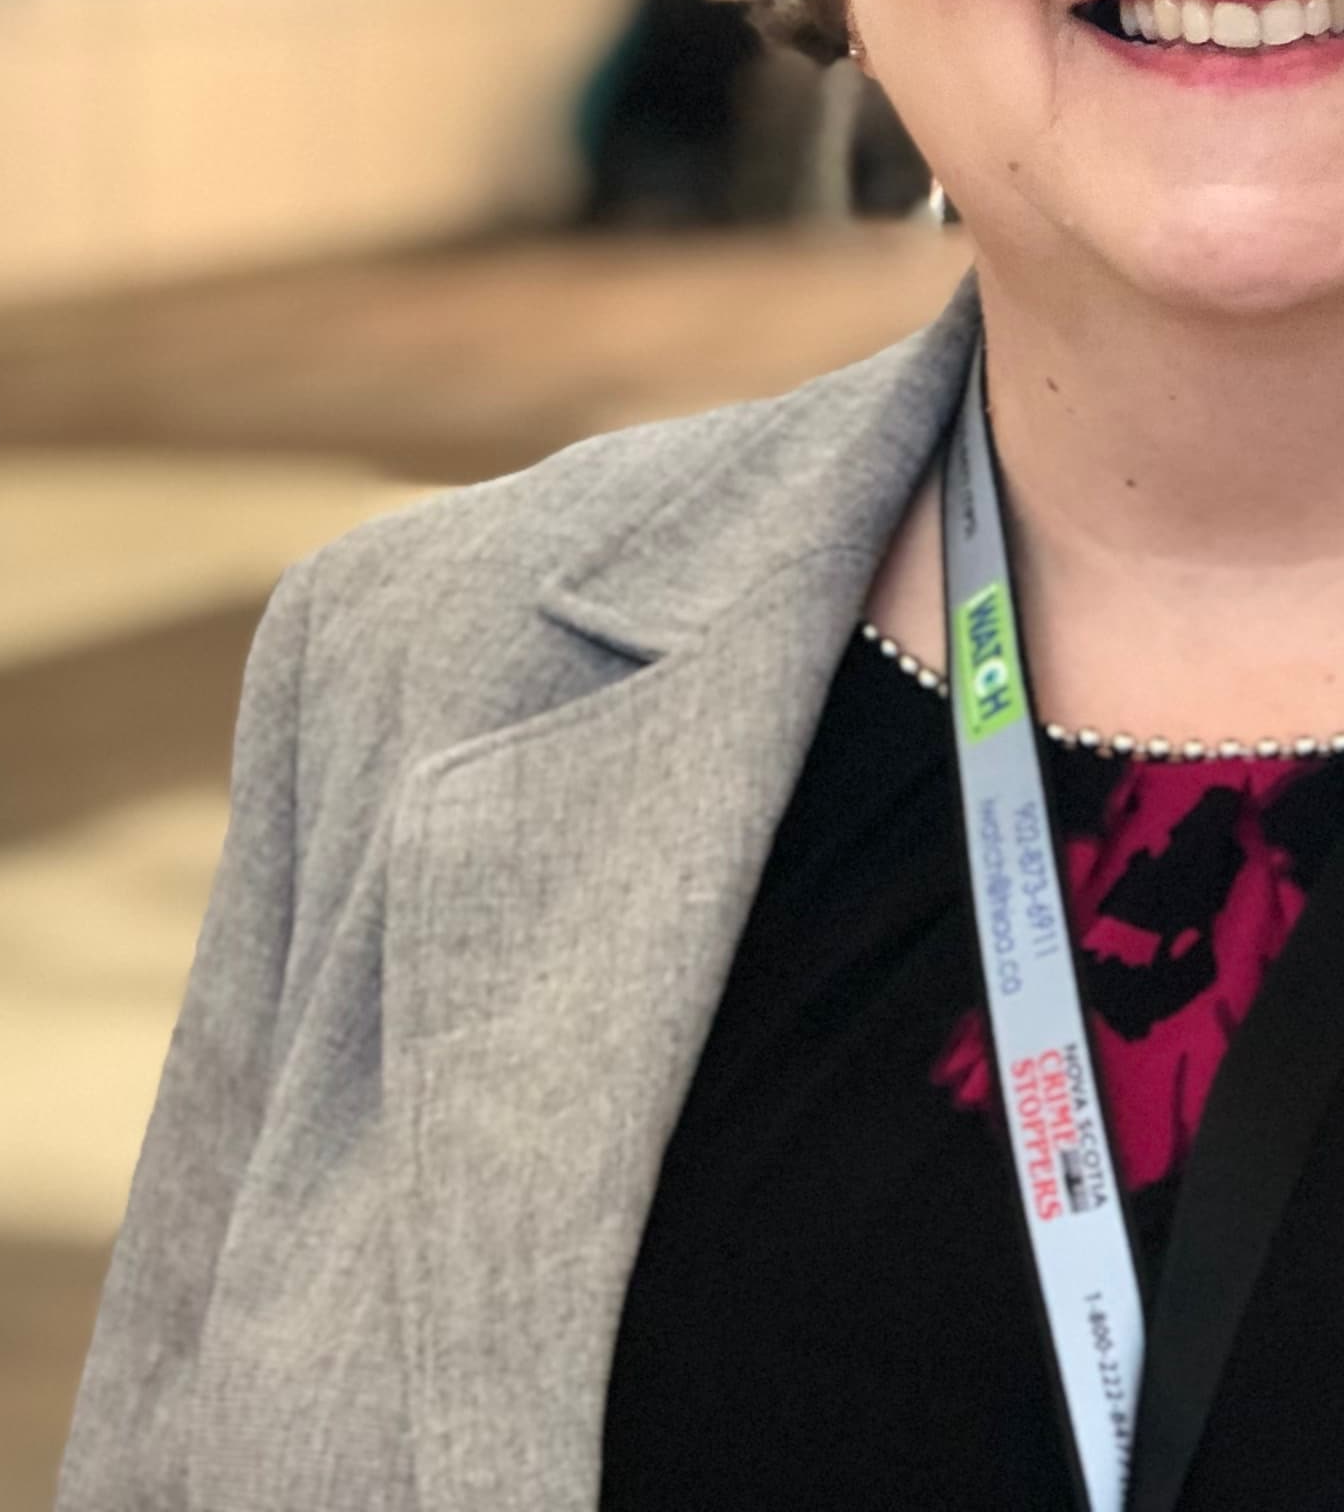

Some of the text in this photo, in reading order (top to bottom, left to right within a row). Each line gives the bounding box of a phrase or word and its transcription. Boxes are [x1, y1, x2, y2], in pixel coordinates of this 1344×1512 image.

[1011, 1057, 1062, 1222] STOPPERS
[1039, 1049, 1080, 1146] CRIME
[1065, 1043, 1108, 1208] NOVA SCOTIA
